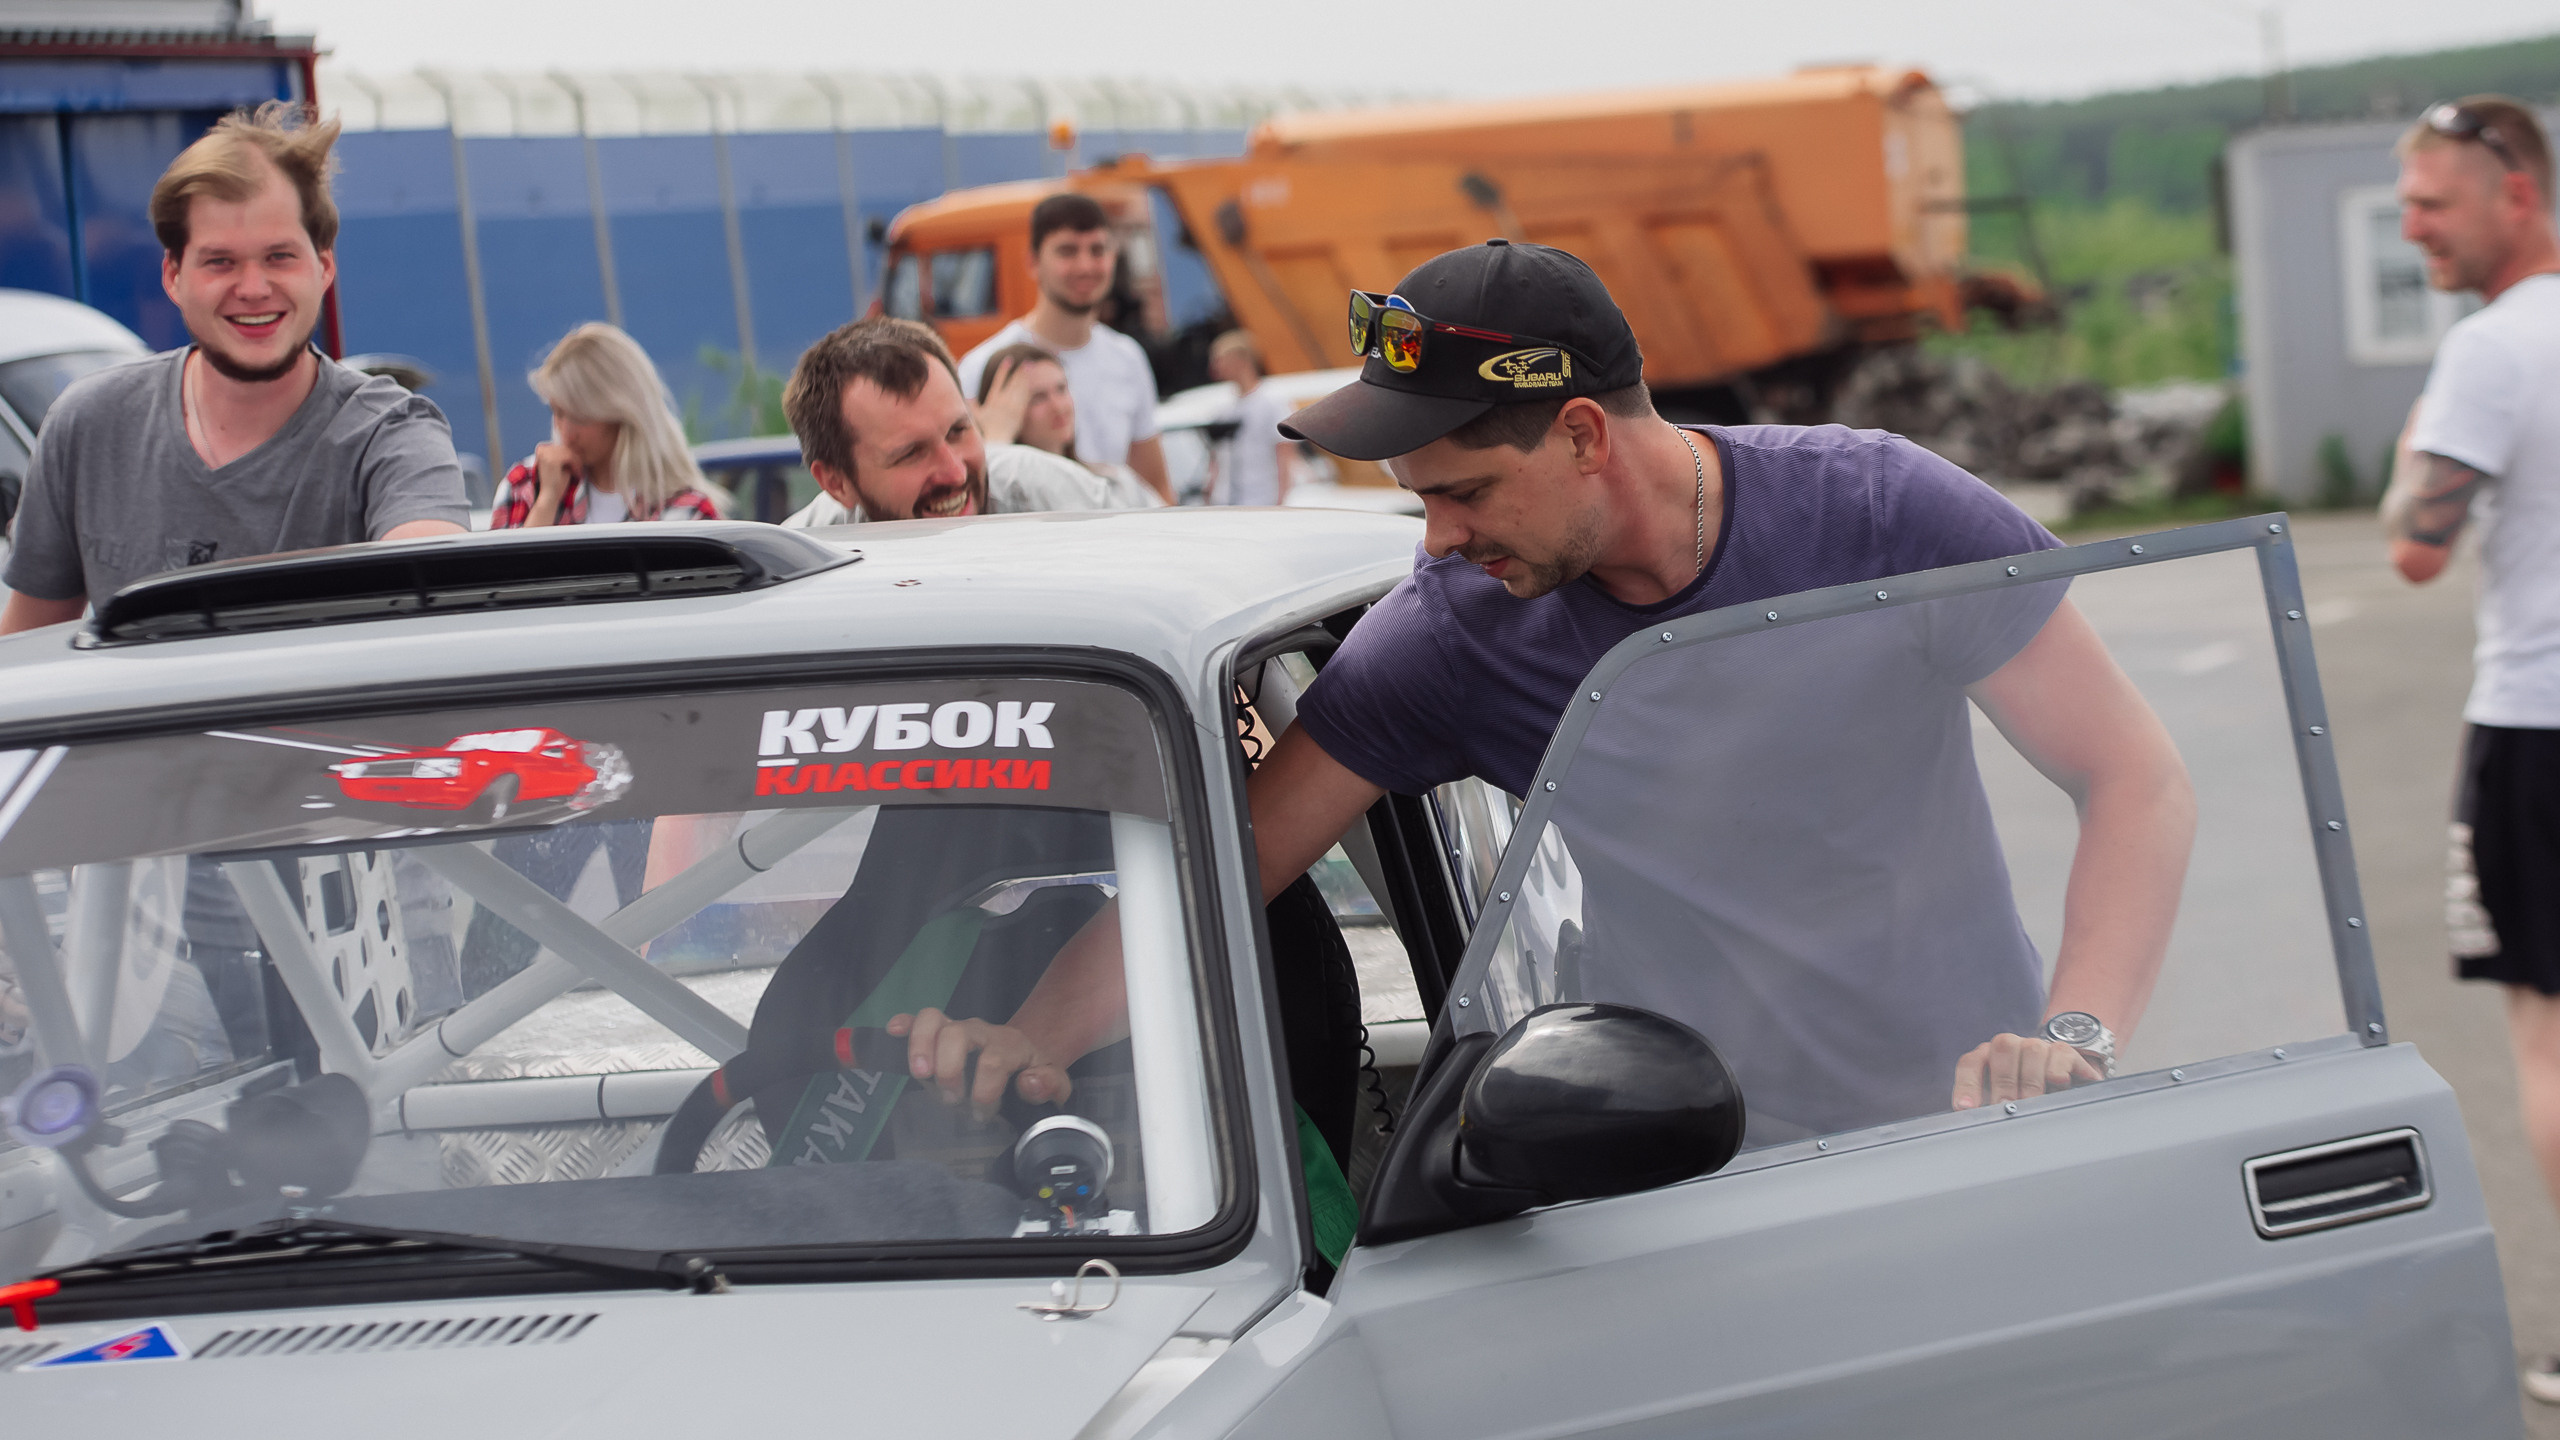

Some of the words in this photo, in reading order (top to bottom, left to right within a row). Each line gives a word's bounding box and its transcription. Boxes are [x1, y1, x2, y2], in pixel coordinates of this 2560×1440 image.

[1514, 372, 1561, 382] SUBARU
[757, 700, 1056, 756] КУБОК
[754, 758, 1051, 797] КЛАССИКИ
